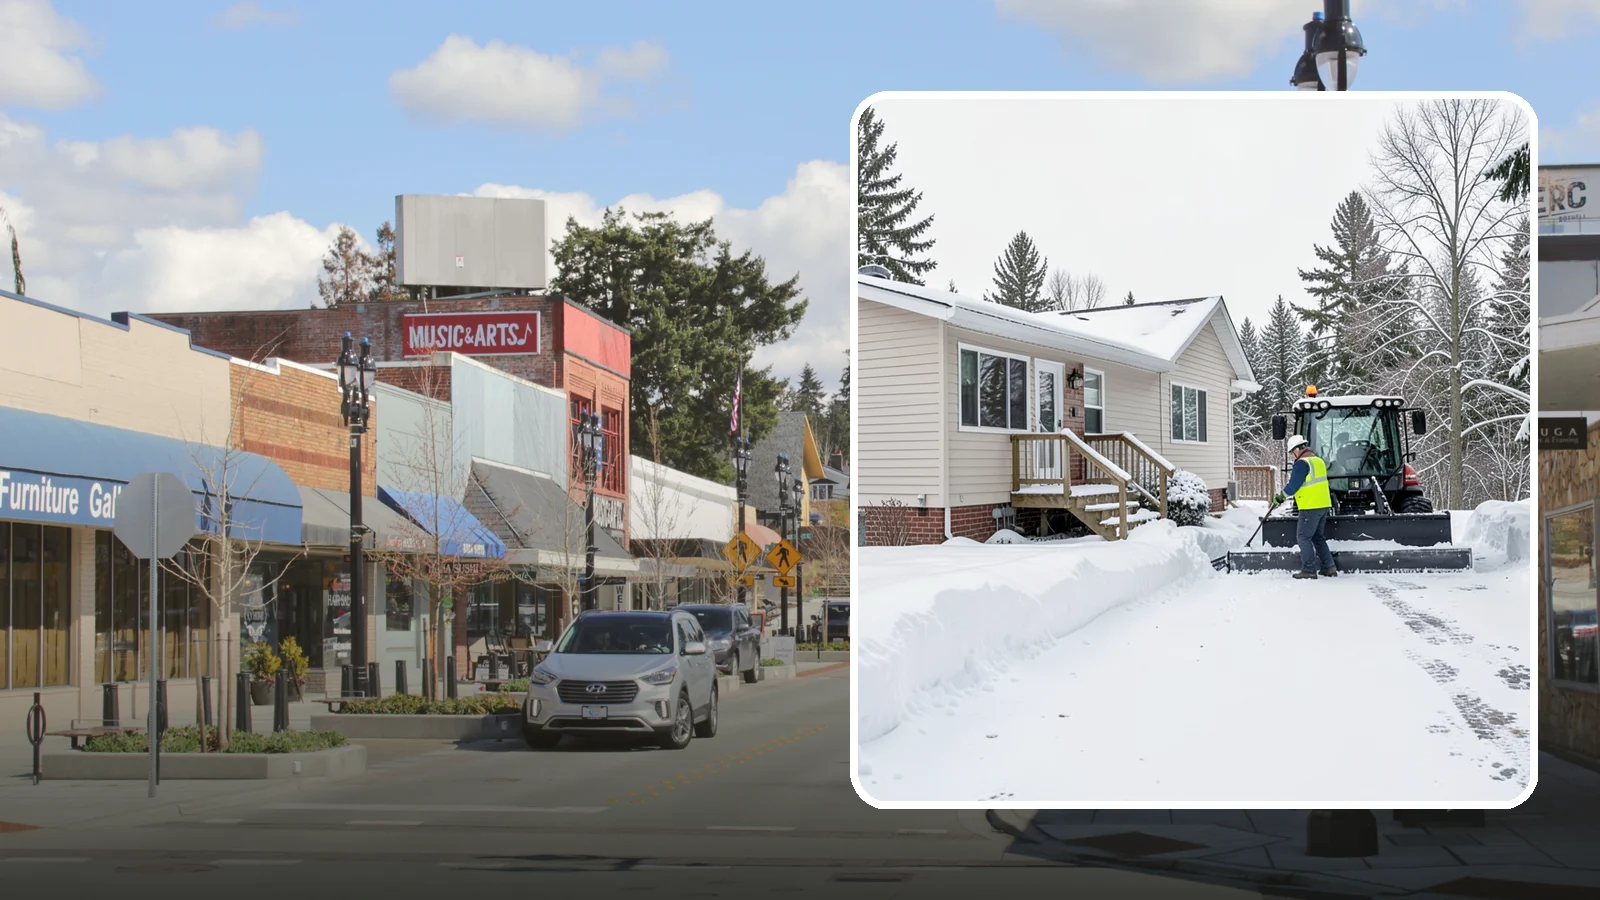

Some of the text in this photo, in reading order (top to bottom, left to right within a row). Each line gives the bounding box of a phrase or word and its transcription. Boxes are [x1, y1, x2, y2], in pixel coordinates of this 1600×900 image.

[1540, 427, 1578, 437] UGA
[0, 471, 122, 519] Furniture Gal
